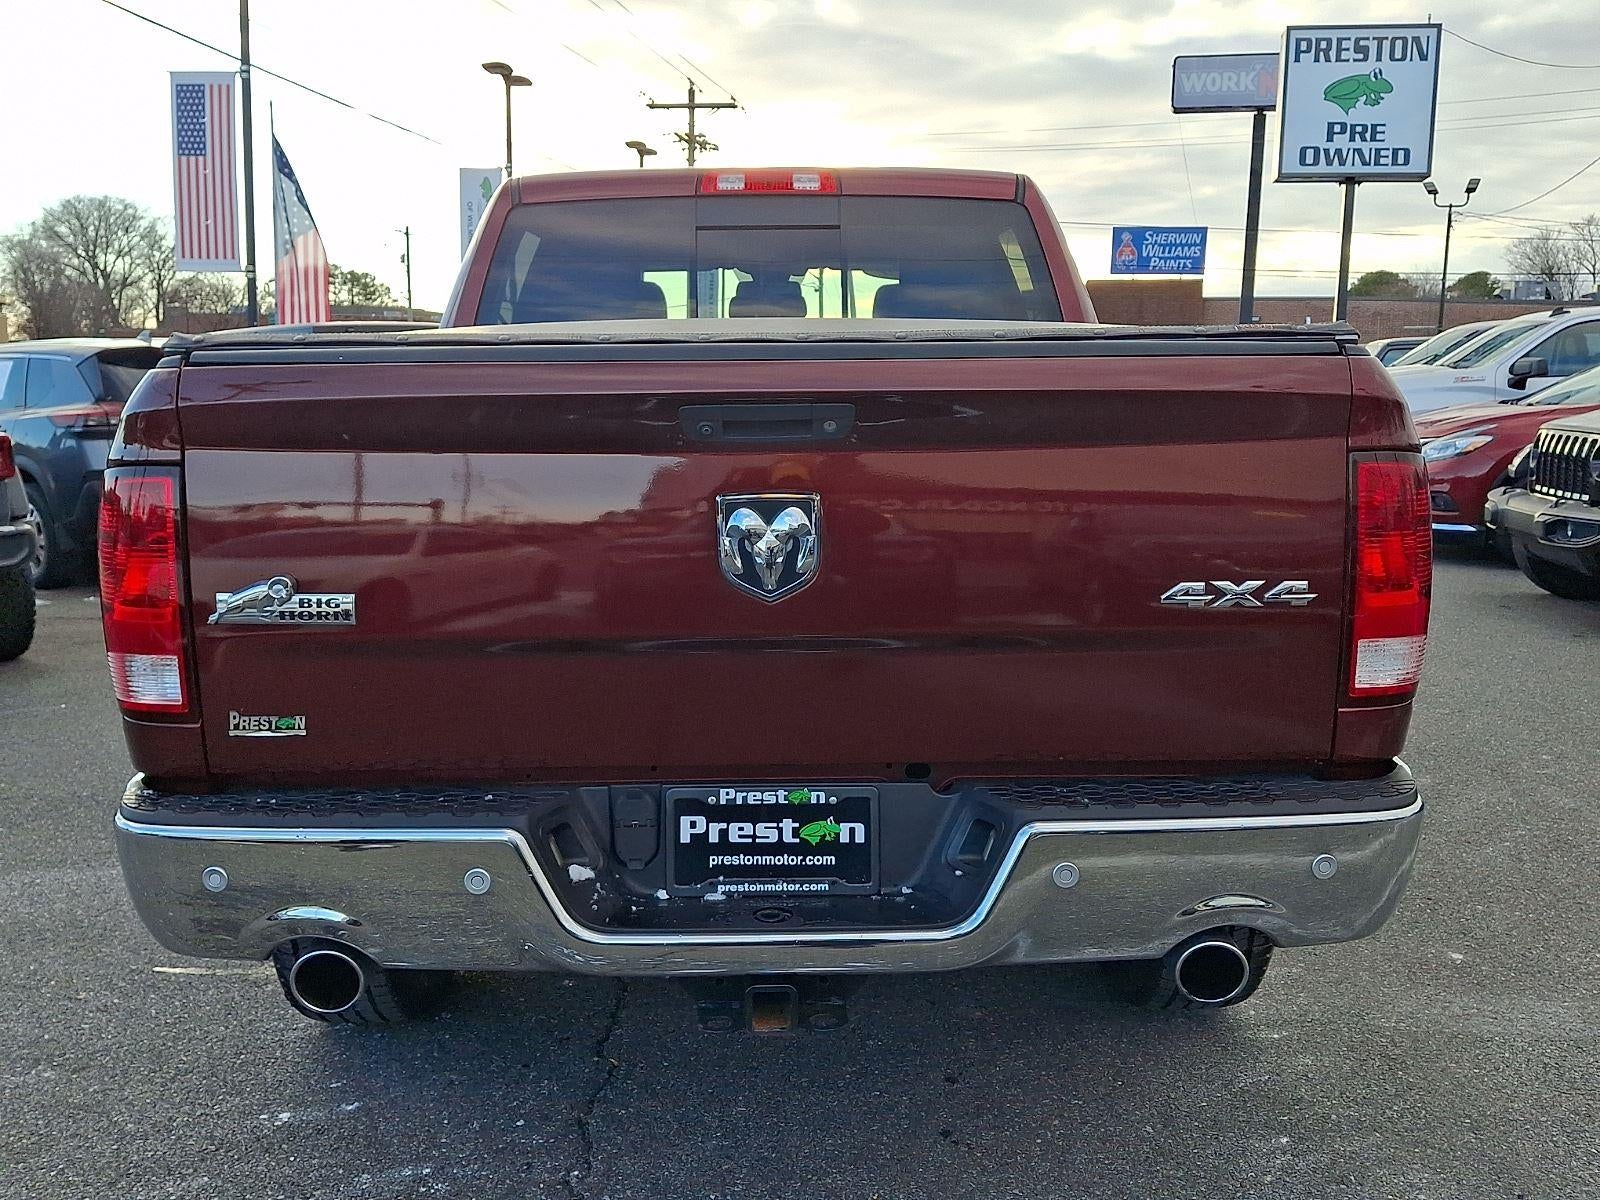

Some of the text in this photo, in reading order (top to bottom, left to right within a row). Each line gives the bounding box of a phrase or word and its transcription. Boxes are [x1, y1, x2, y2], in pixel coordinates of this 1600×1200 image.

[1293, 35, 1431, 63] PRESTON
[1325, 121, 1387, 143] PRE
[1298, 145, 1412, 167] OWNED
[1143, 230, 1202, 244] SHERWIN
[1141, 244, 1202, 257] WILLIAMS
[1148, 257, 1193, 271] PAINTS
[298, 597, 341, 609] BIG
[277, 609, 353, 622] HORN
[709, 853, 836, 868] prestonmotor.com
[717, 882, 829, 893] prestonmotor.com
